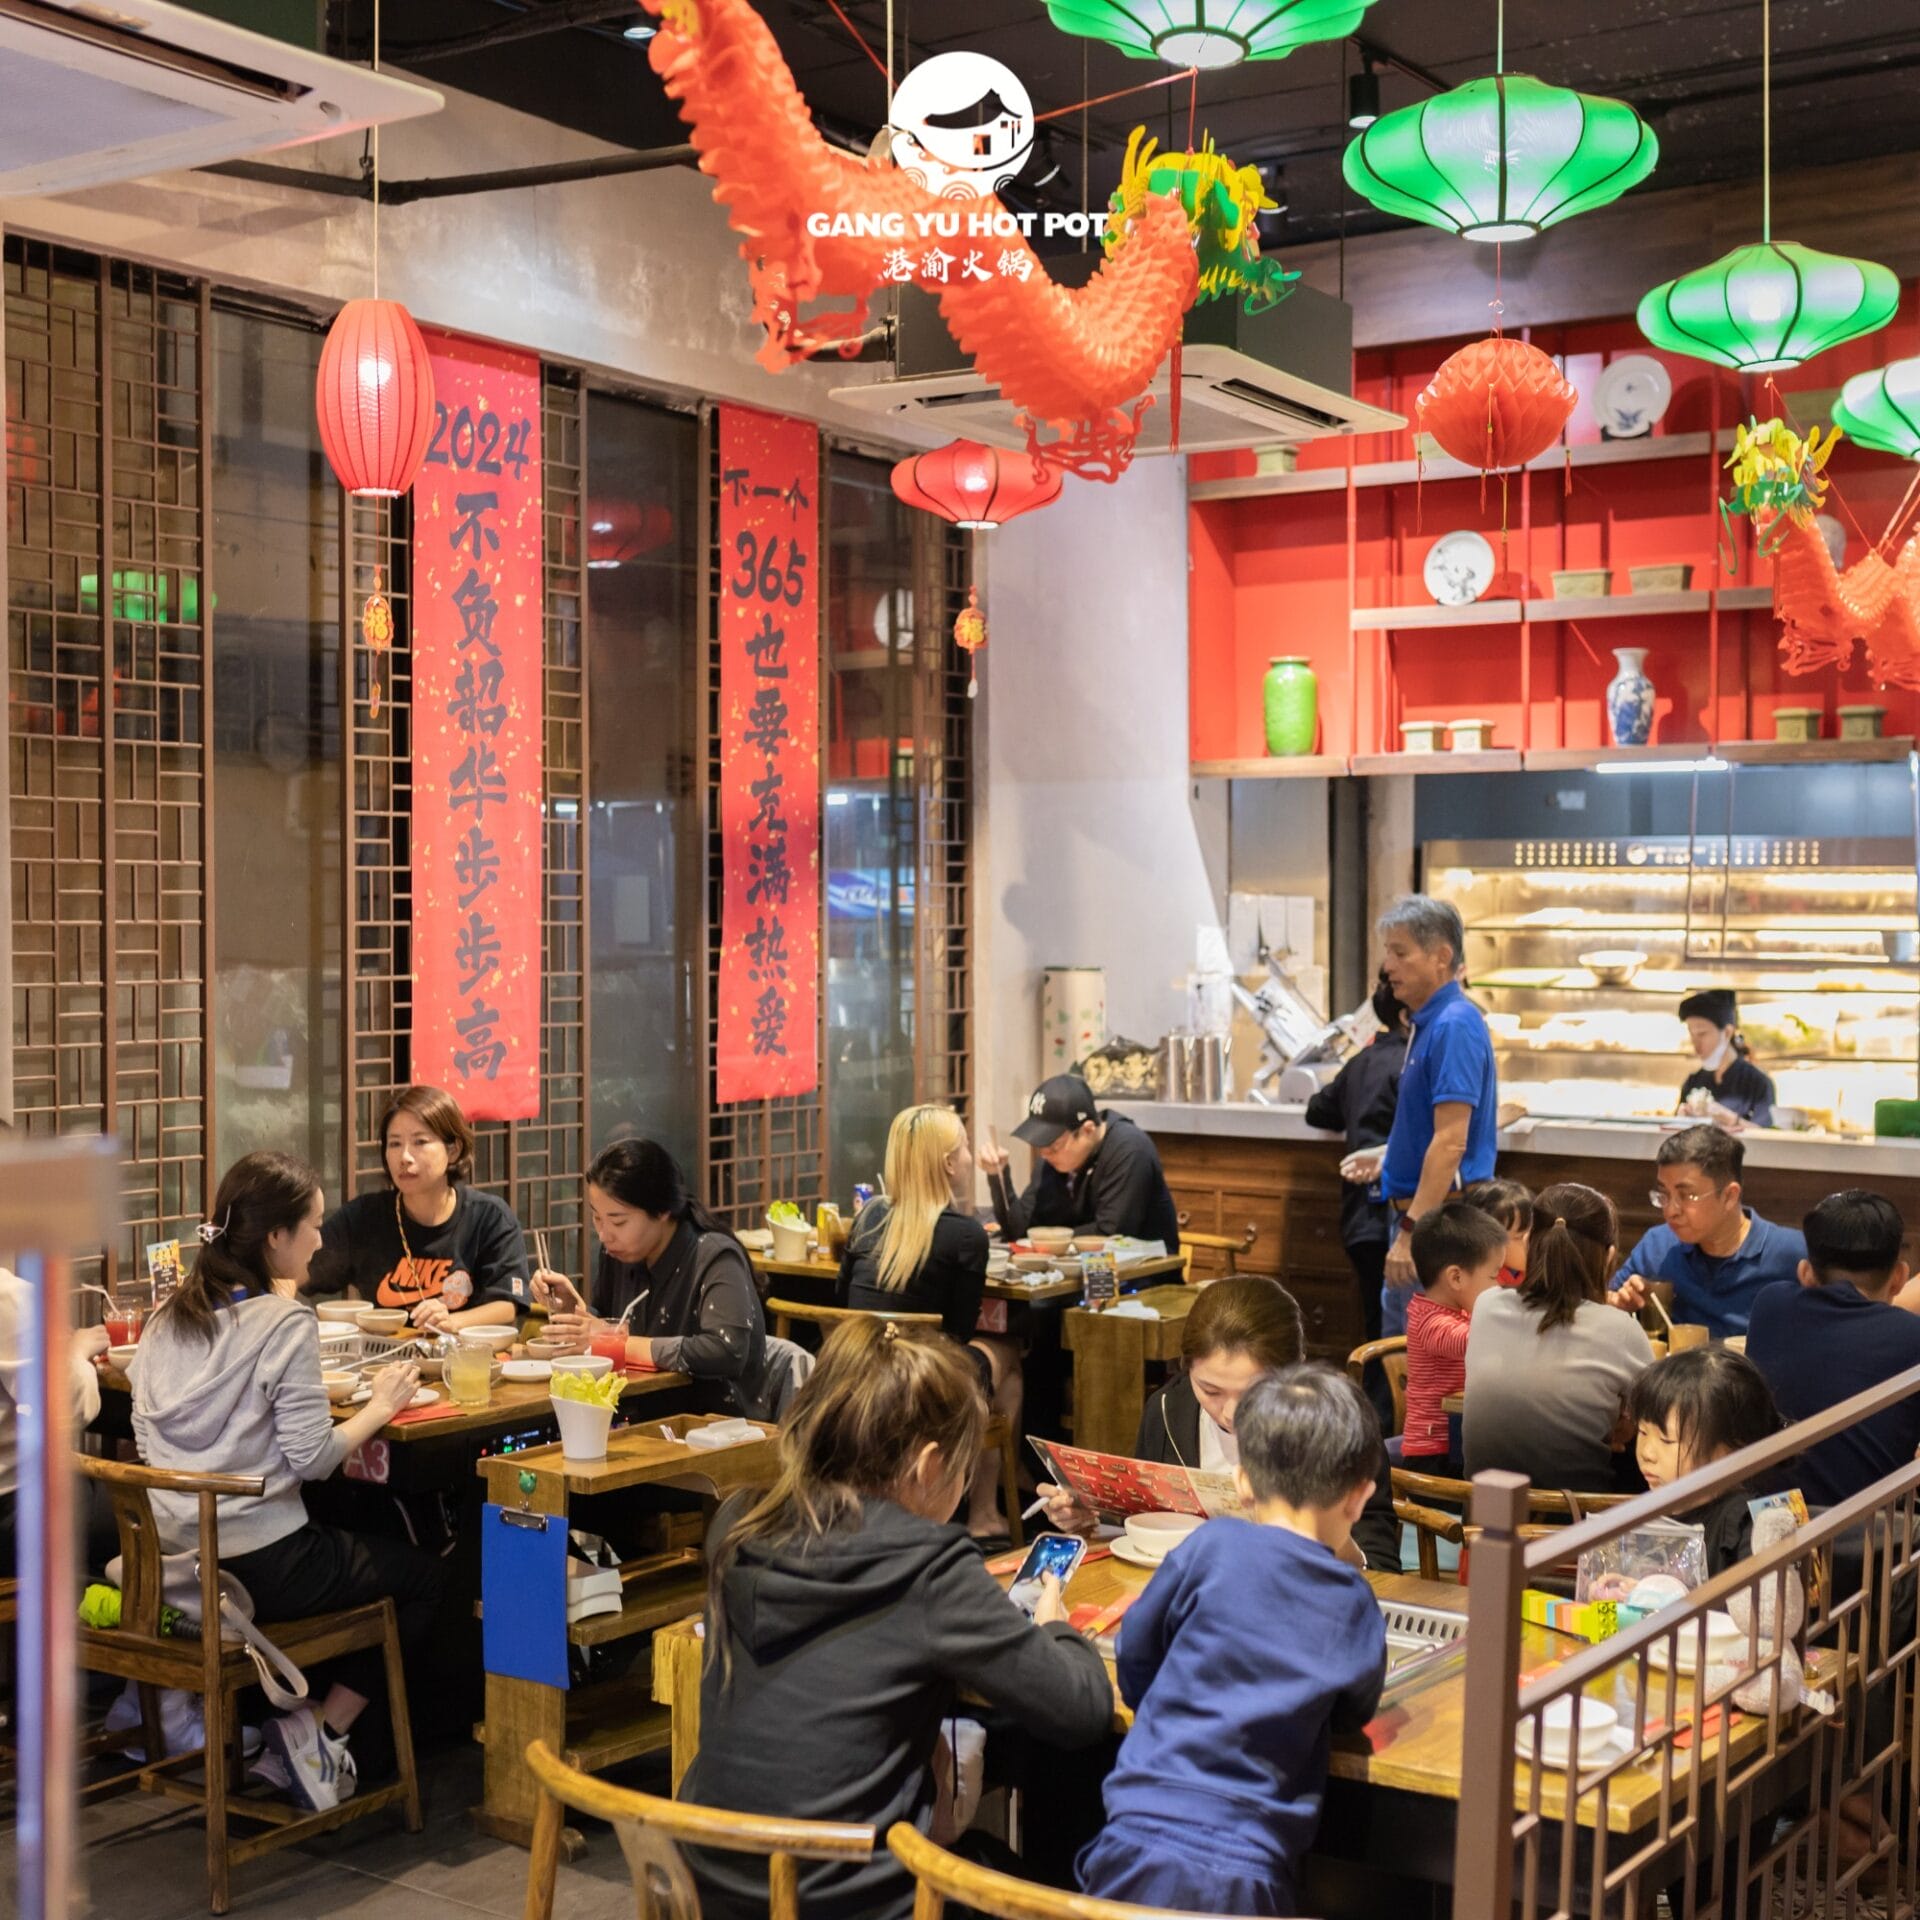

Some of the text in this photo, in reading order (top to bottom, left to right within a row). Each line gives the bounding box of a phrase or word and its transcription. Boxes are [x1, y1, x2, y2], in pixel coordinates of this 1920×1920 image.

[425, 402, 531, 480] 2024
[723, 467, 809, 521] 下一个
[731, 531, 808, 607] 365
[448, 490, 508, 1082] 不负韶华步步高
[743, 612, 791, 1057] 也要充满热爱
[390, 1257, 454, 1289] NIKE
[343, 1439, 390, 1484] A3
